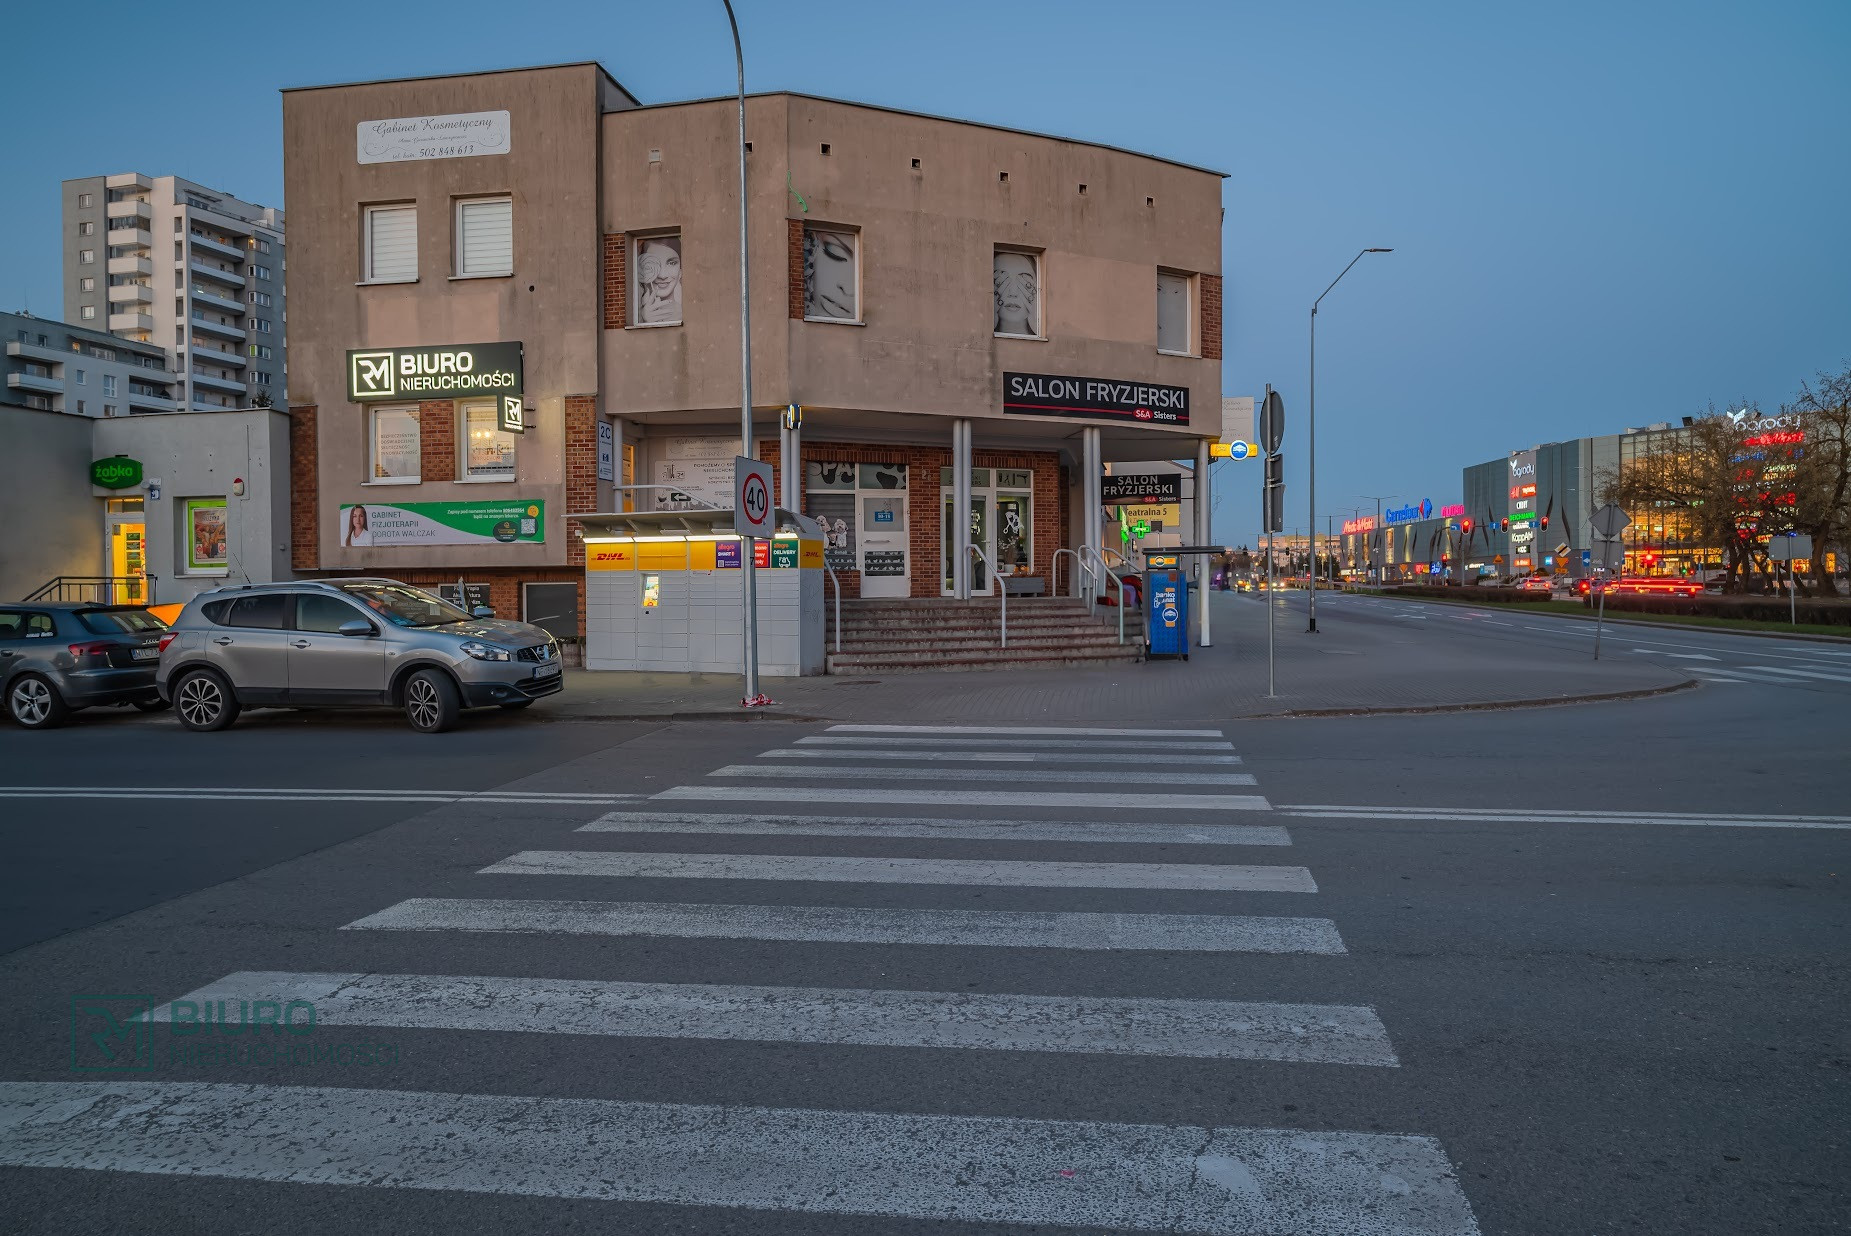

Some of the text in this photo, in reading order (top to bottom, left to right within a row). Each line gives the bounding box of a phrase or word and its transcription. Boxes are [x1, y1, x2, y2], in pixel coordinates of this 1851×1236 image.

[373, 118, 493, 138] Gabinet Kosmetyczny
[419, 148, 435, 157] 502
[438, 147, 454, 156] 848
[457, 145, 474, 154] 613
[400, 352, 473, 375] BIURO
[400, 370, 515, 391] NIERUCHOMOŚCI
[1011, 377, 1184, 409] SALON FRYZJERSKI
[1135, 409, 1177, 420] S&A Sisters
[600, 425, 611, 439] 2C
[95, 465, 133, 478] żabka
[1117, 475, 1158, 485] SALON
[1103, 484, 1173, 495] FRYZJERSKI
[747, 487, 765, 512] 40
[1162, 507, 1167, 516] 5
[1386, 504, 1420, 522] Carrefour
